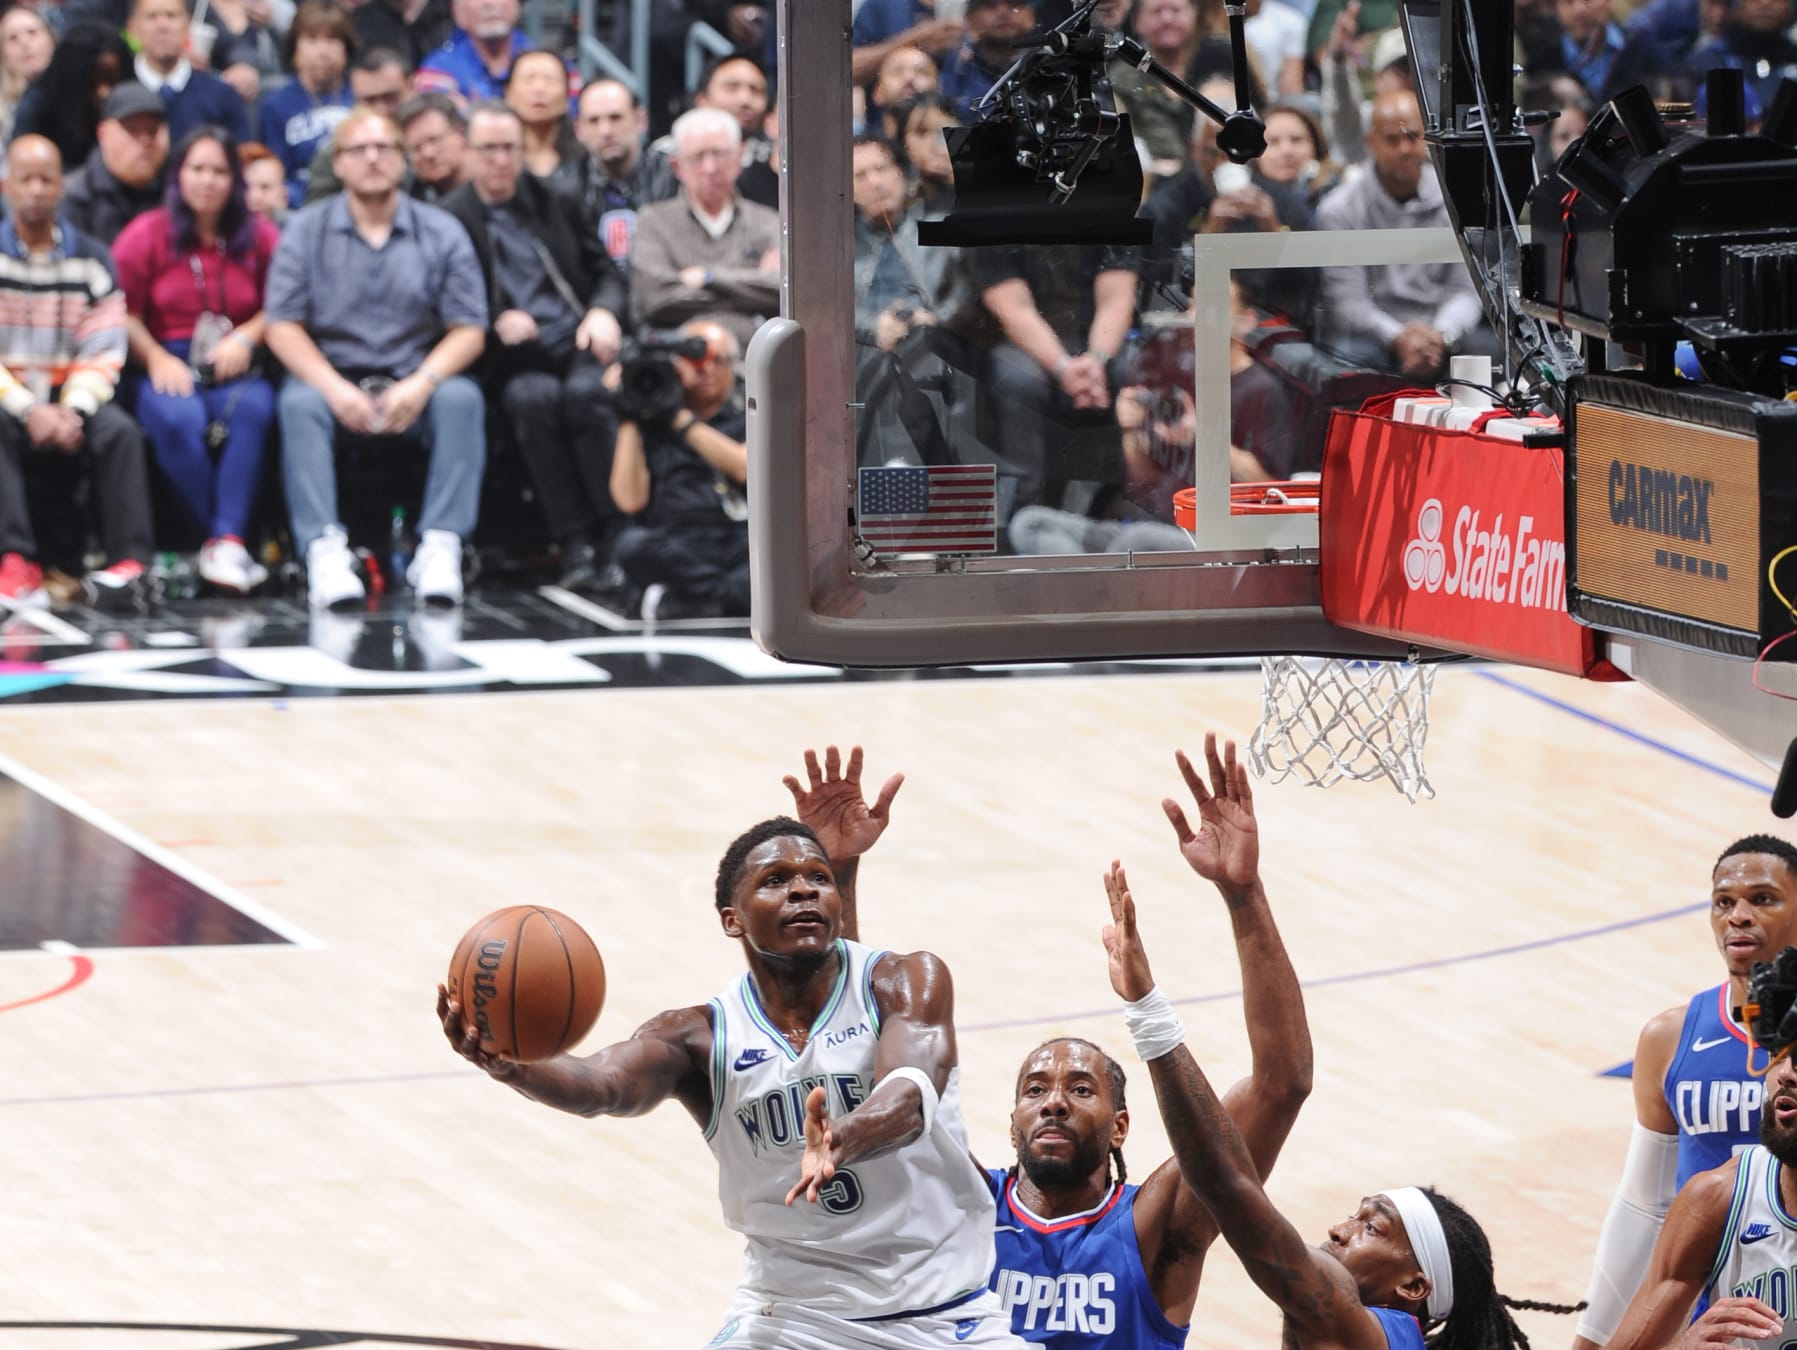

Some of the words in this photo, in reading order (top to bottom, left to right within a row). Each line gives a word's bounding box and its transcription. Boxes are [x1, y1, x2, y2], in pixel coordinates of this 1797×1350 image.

[1444, 505, 1509, 601] State
[473, 938, 508, 1042] Wilson
[740, 1048, 768, 1062] NIKE
[734, 1073, 875, 1159] WOLVE
[1676, 1080, 1769, 1136] CLIPP
[1746, 1223, 1772, 1236] NIKE
[996, 1268, 1116, 1336] IPPERS
